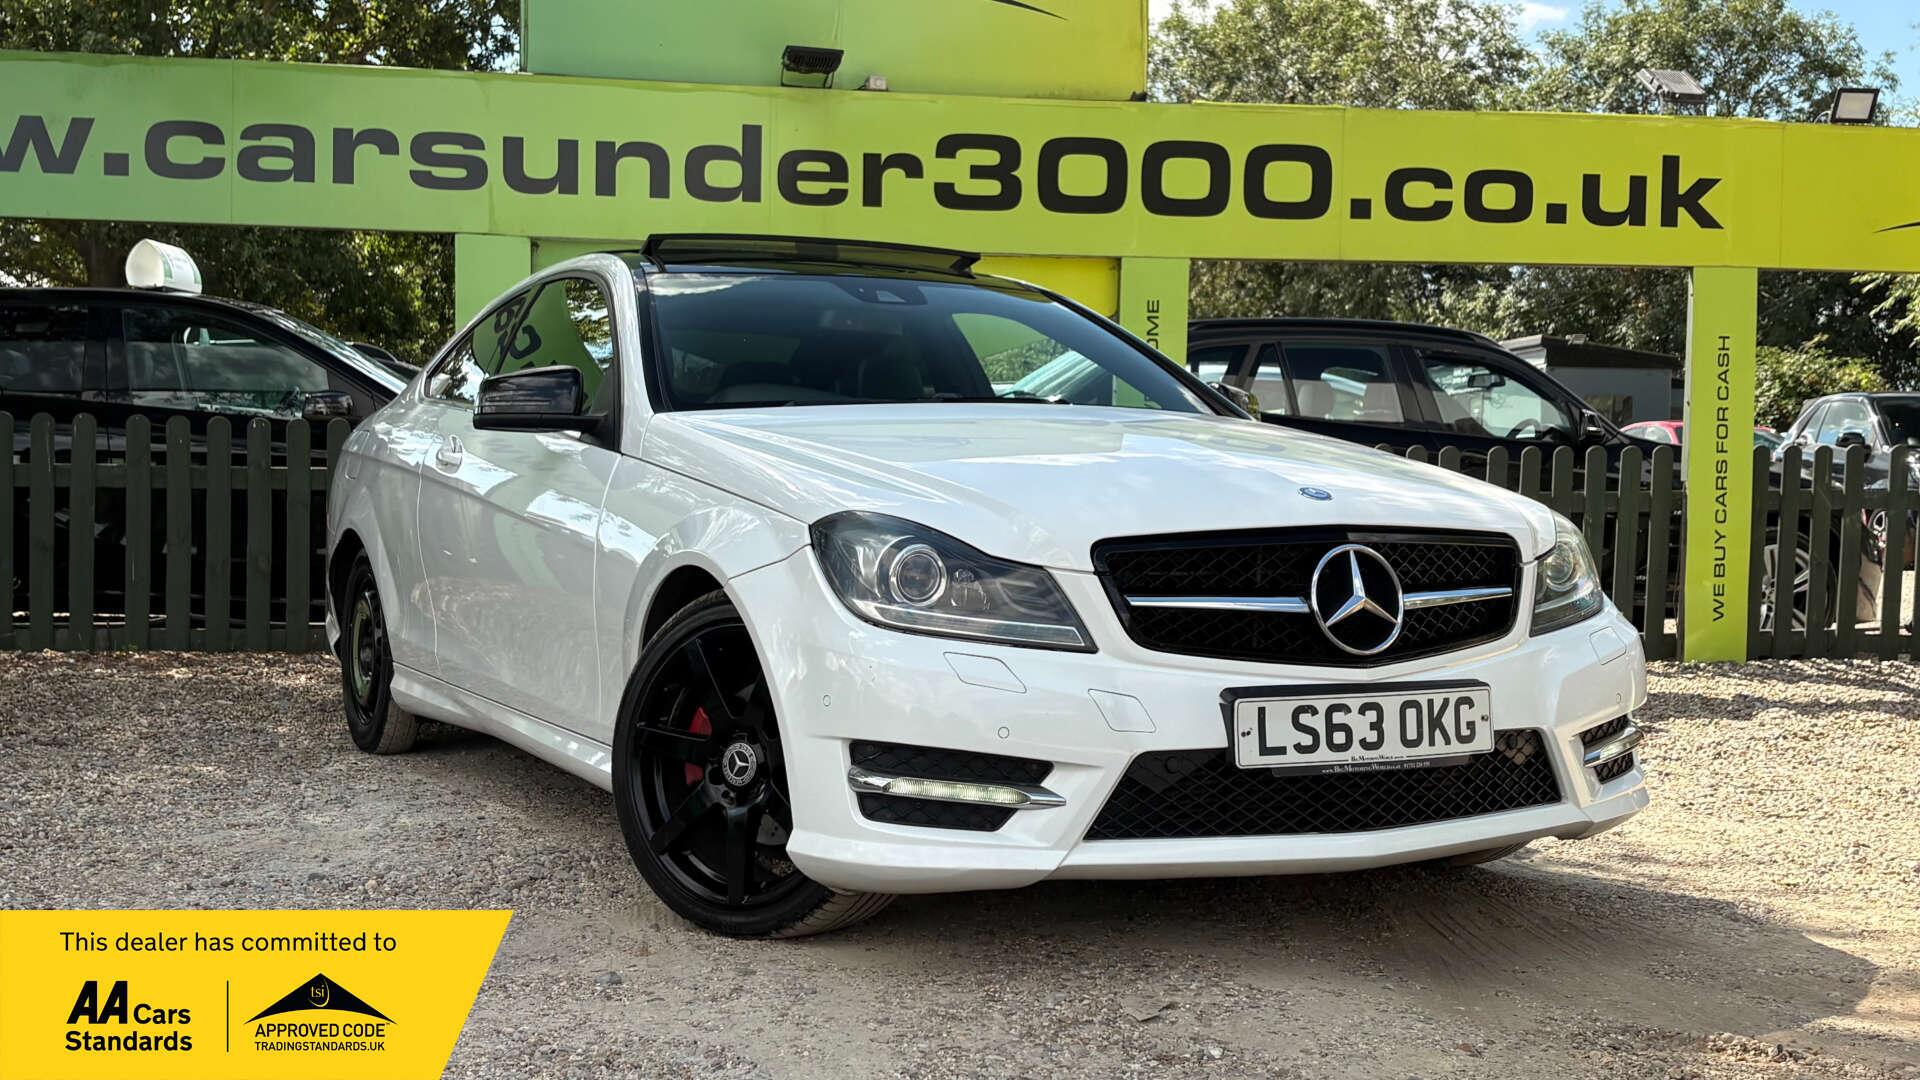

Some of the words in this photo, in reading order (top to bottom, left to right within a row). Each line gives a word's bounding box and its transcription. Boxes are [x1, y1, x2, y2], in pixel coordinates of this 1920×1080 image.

[0, 115, 1723, 230] w.carsunder3000.co.uk
[1717, 335, 1731, 401] CASH
[1716, 406, 1729, 454] FOR
[1715, 459, 1728, 524] CARS
[1713, 529, 1727, 578] BUY
[1712, 583, 1725, 622] WE
[1257, 702, 1385, 757] LS63
[1399, 696, 1476, 748] OKG
